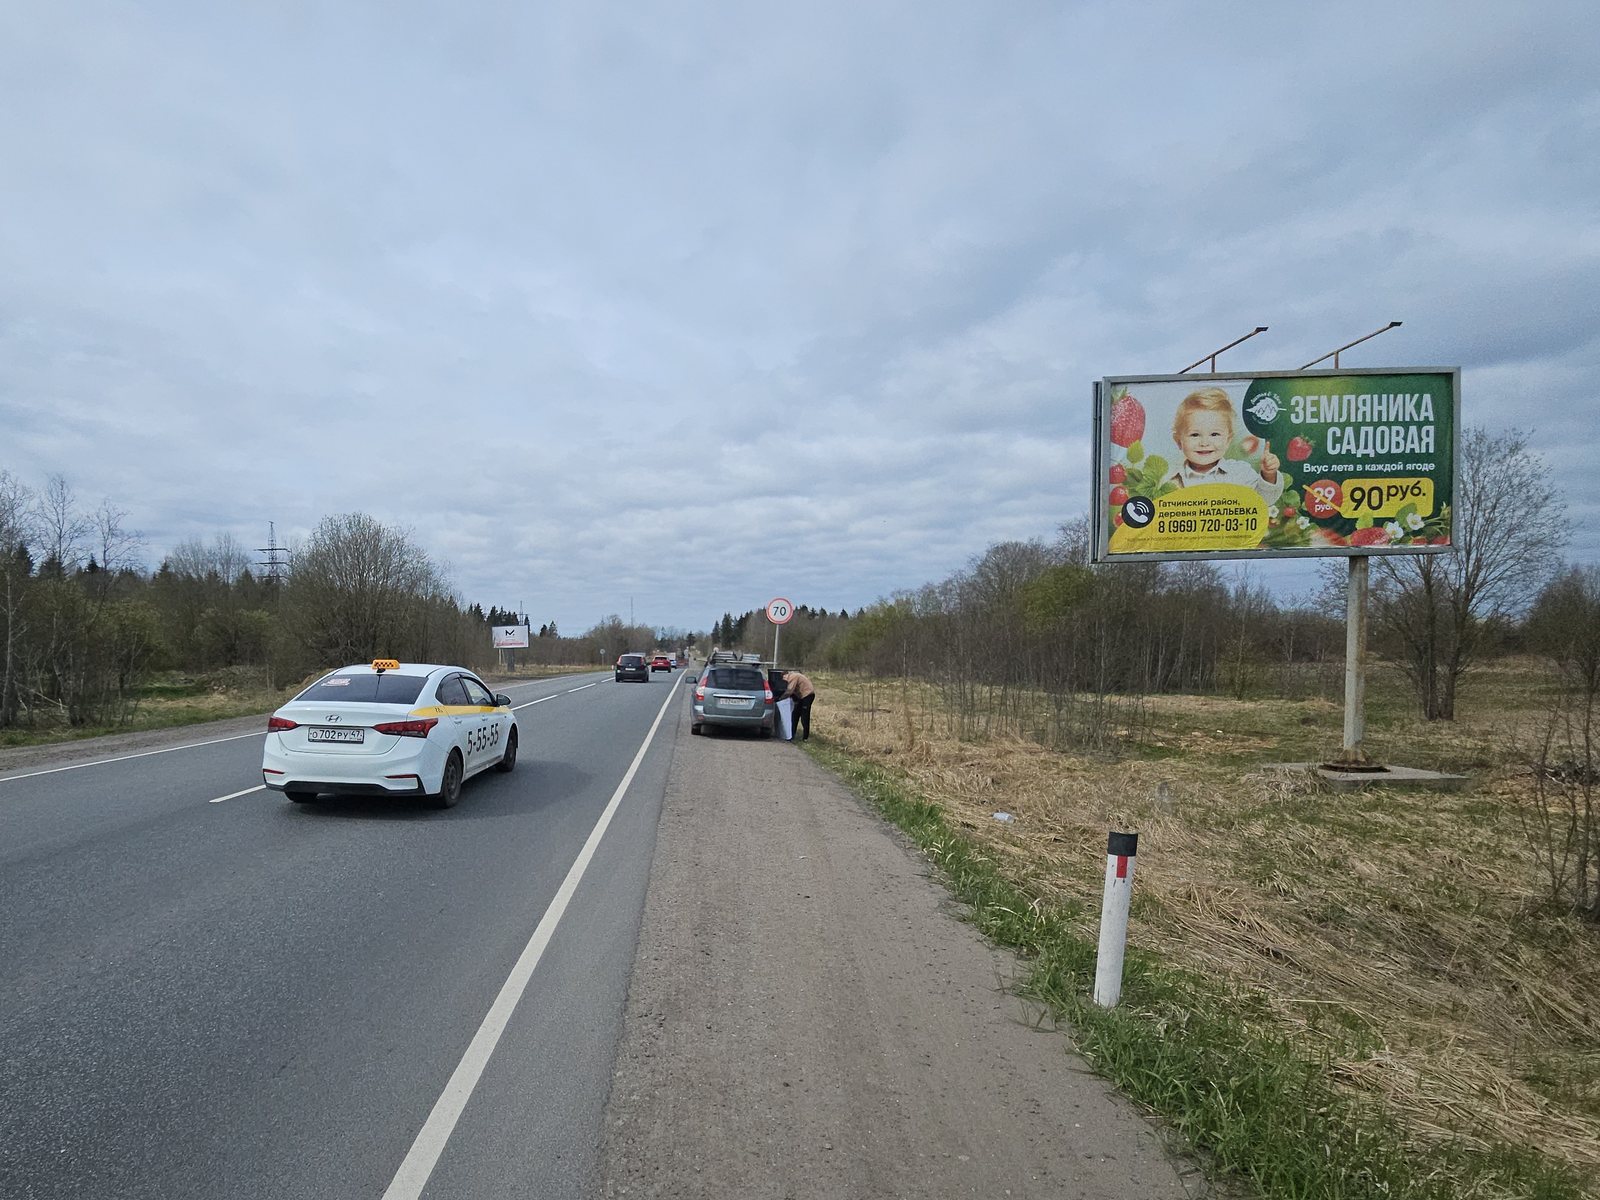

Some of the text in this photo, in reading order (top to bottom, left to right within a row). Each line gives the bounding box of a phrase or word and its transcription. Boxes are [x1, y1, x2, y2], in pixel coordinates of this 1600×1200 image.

[1290, 393, 1435, 424] ЗЕМЛЯНИКА
[1326, 425, 1435, 458] САДОВАЯ
[1303, 461, 1436, 474] Вкус лета в каждой ягоде
[1158, 499, 1208, 508] Гатчинский
[1349, 480, 1426, 511] 90 руб.
[1158, 507, 1258, 519] деревня НАТАЛЬЕВКА
[1158, 517, 1257, 533] 8 (969) 720-03-10
[773, 606, 787, 617] 70
[467, 722, 499, 756] 5-55-55
